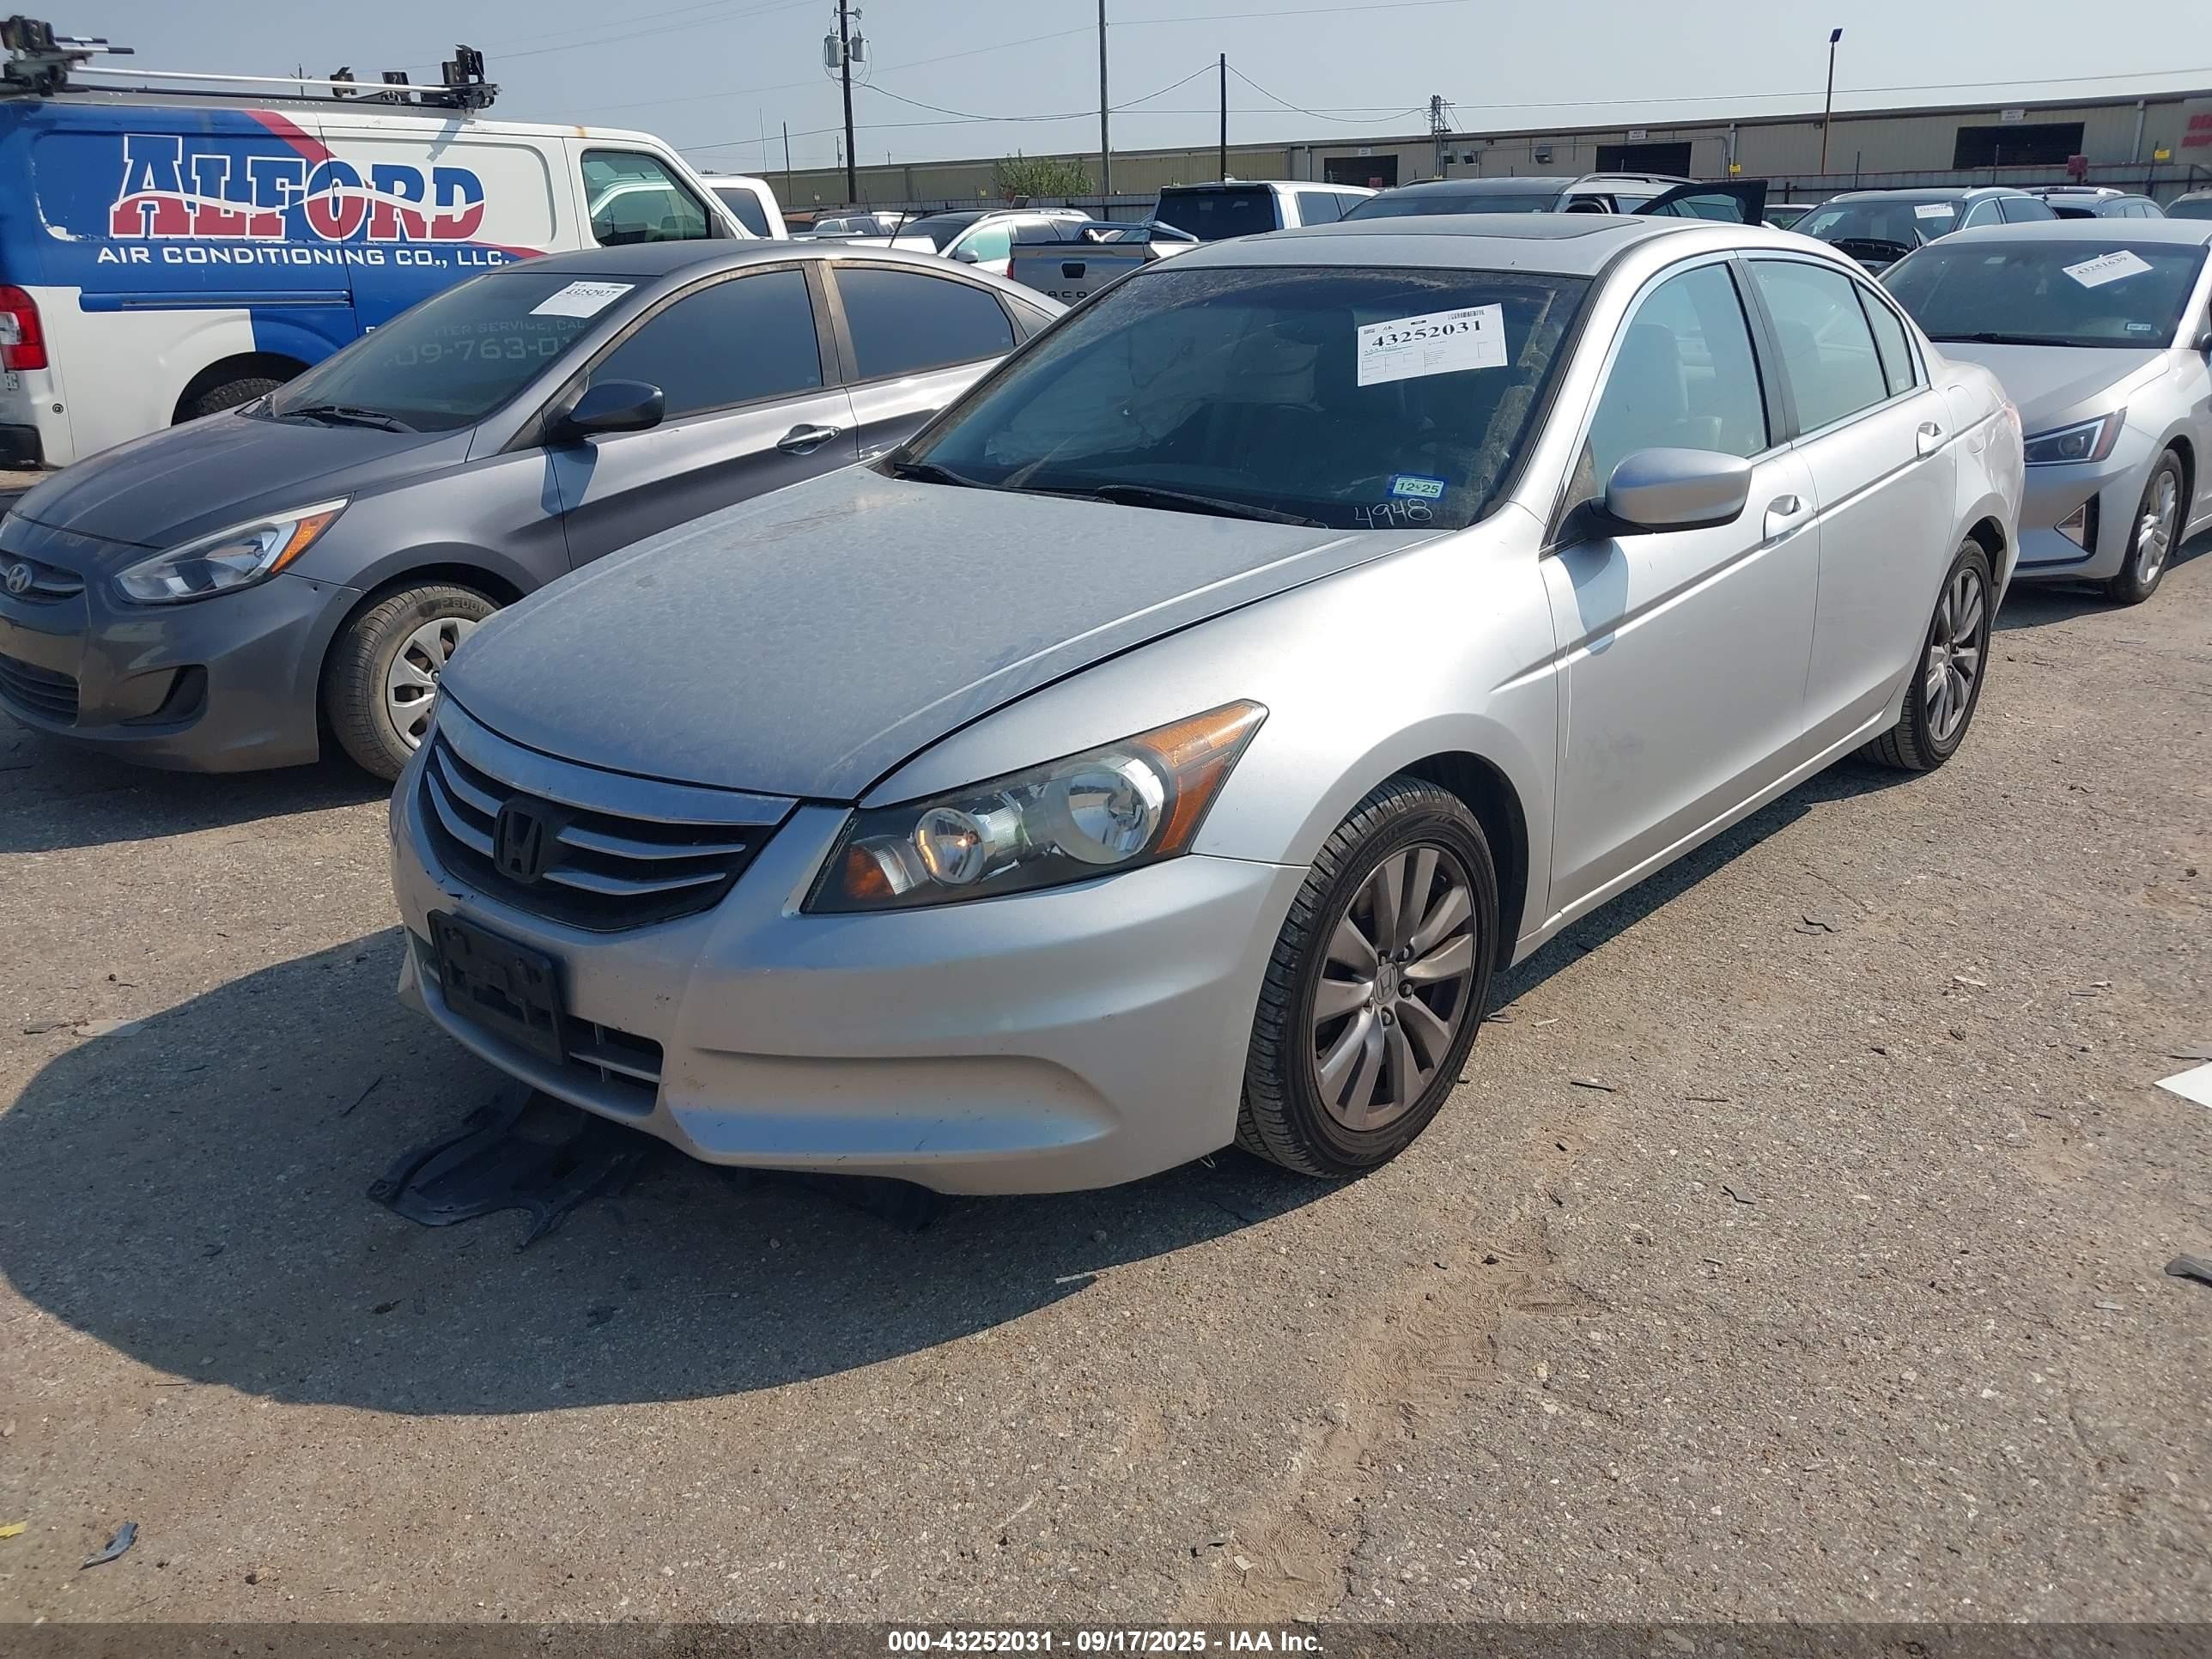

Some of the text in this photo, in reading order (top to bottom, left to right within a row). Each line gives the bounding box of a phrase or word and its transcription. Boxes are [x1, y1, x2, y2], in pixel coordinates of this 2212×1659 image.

[110, 133, 486, 242] ALFORD
[97, 246, 510, 269] AIR CONDITIONING CO., LLC.
[1371, 319, 1483, 347] 43252031
[1354, 498, 1432, 528] 4948
